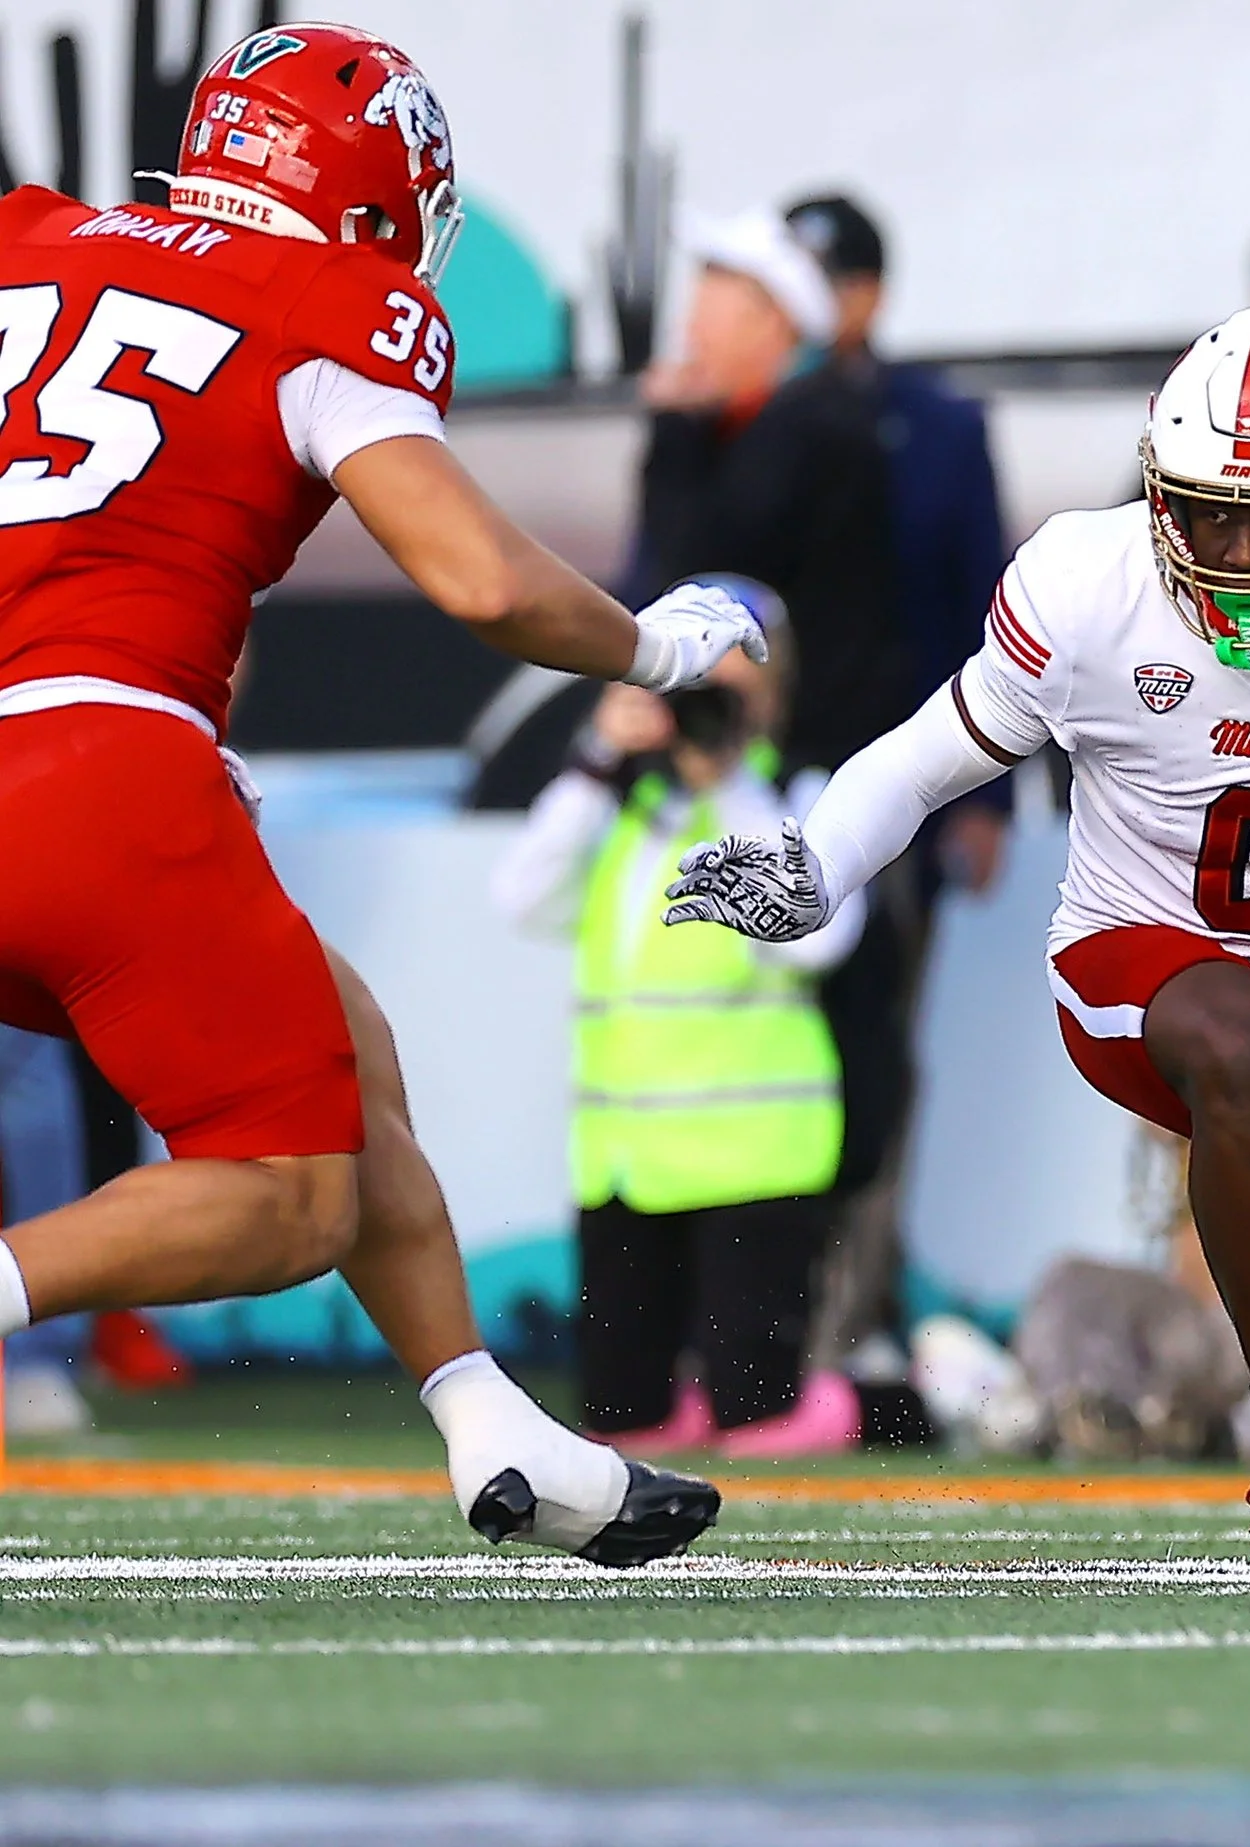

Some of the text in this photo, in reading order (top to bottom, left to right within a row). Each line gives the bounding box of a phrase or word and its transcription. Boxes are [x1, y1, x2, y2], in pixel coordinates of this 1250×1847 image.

[210, 92, 249, 123] 35
[214, 194, 273, 225] STATE
[369, 290, 450, 392] 35
[1160, 511, 1196, 563] Riddell
[1138, 680, 1189, 697] MAC
